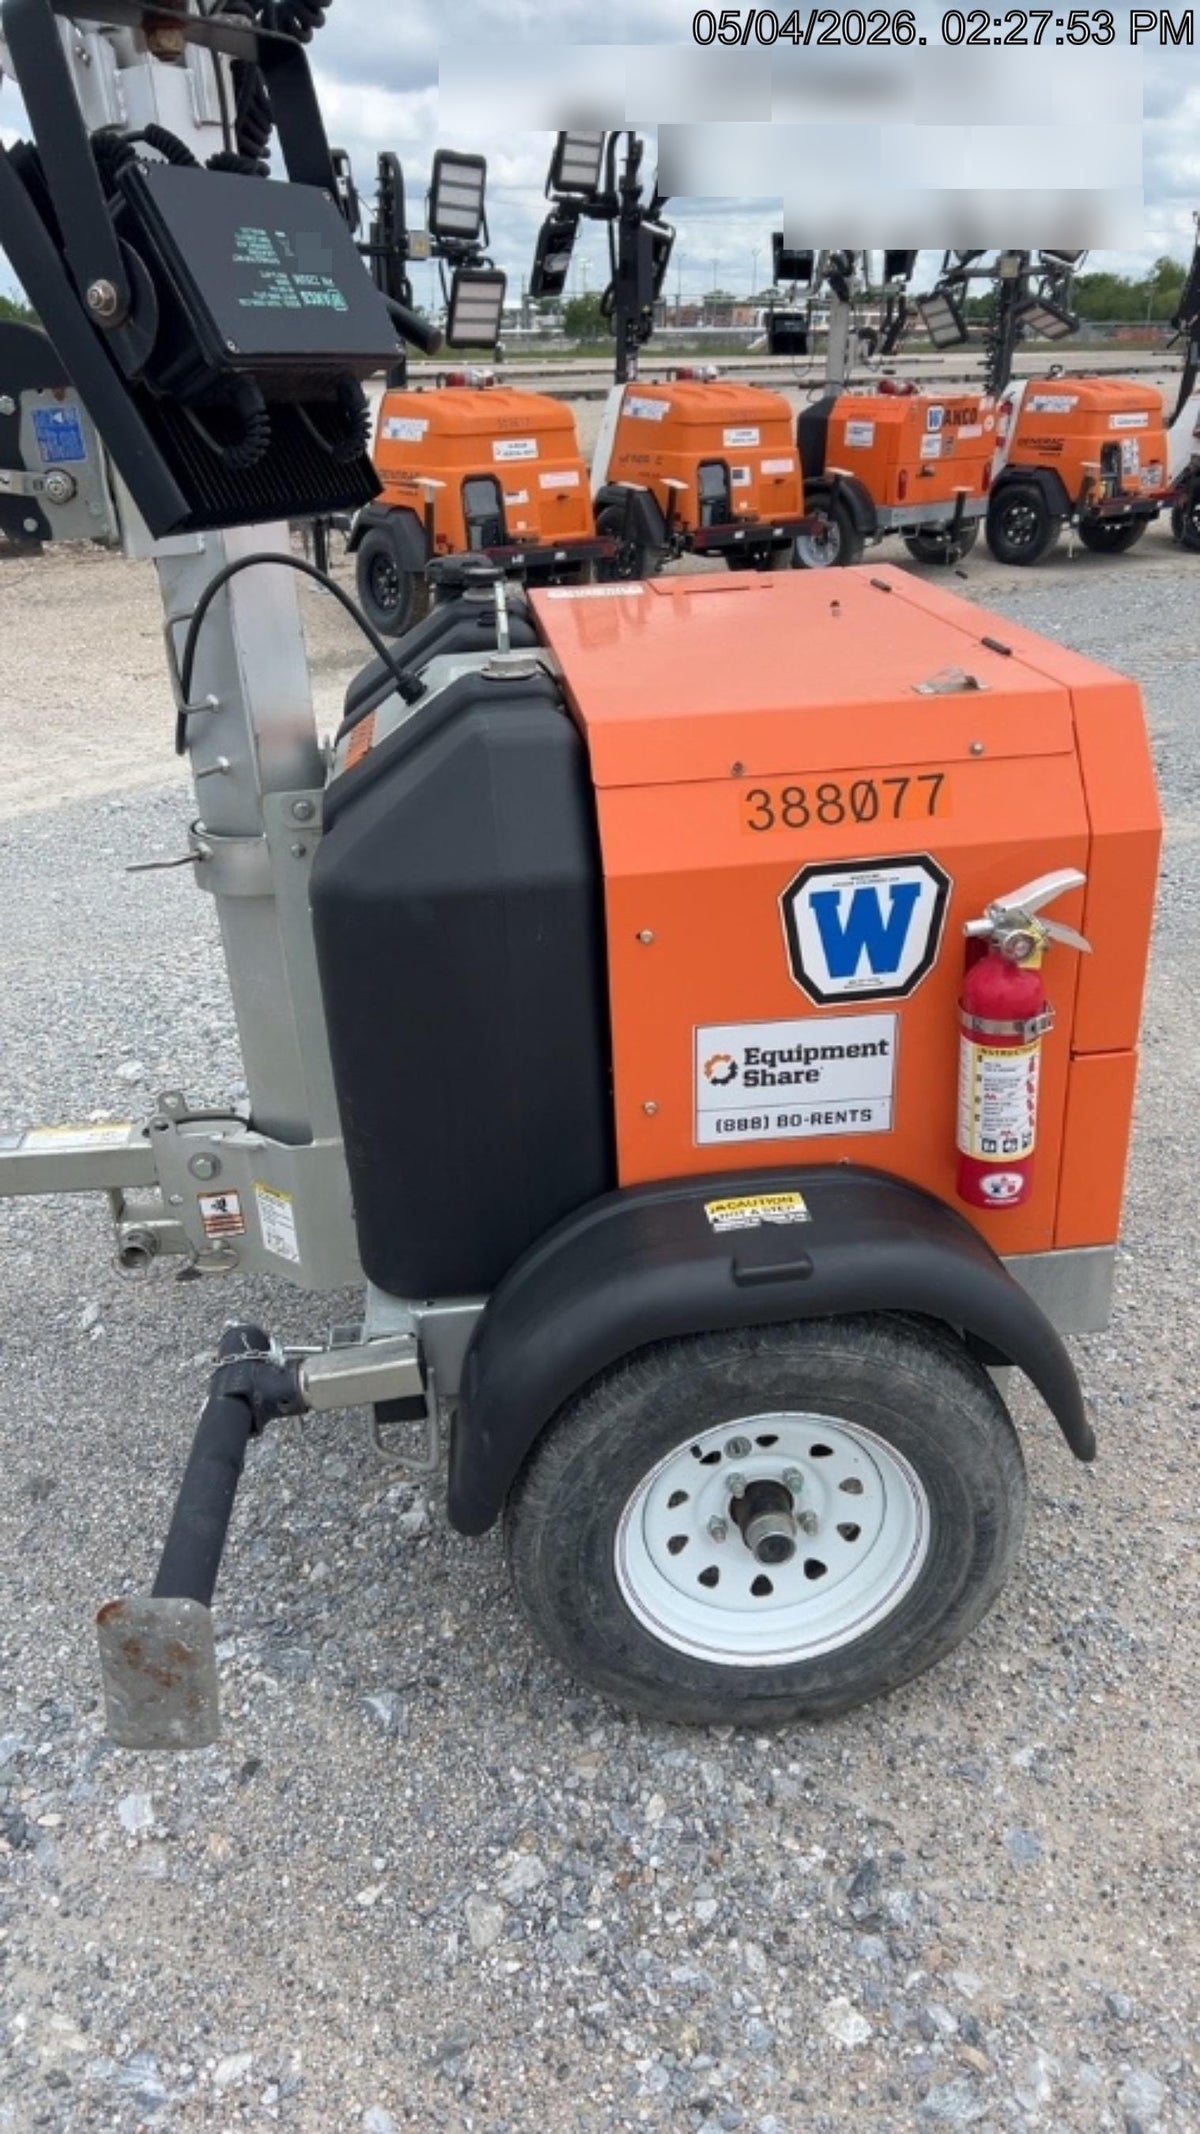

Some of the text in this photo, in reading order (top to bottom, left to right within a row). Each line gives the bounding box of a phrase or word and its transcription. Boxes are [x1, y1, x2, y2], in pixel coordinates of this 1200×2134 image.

[809, 881, 921, 979] W
[743, 1038, 890, 1068] Equipment
[743, 1068, 820, 1088] Share
[716, 1108, 873, 1134] (888) 80-RENTS
[729, 1196, 794, 1209] CAUTION
